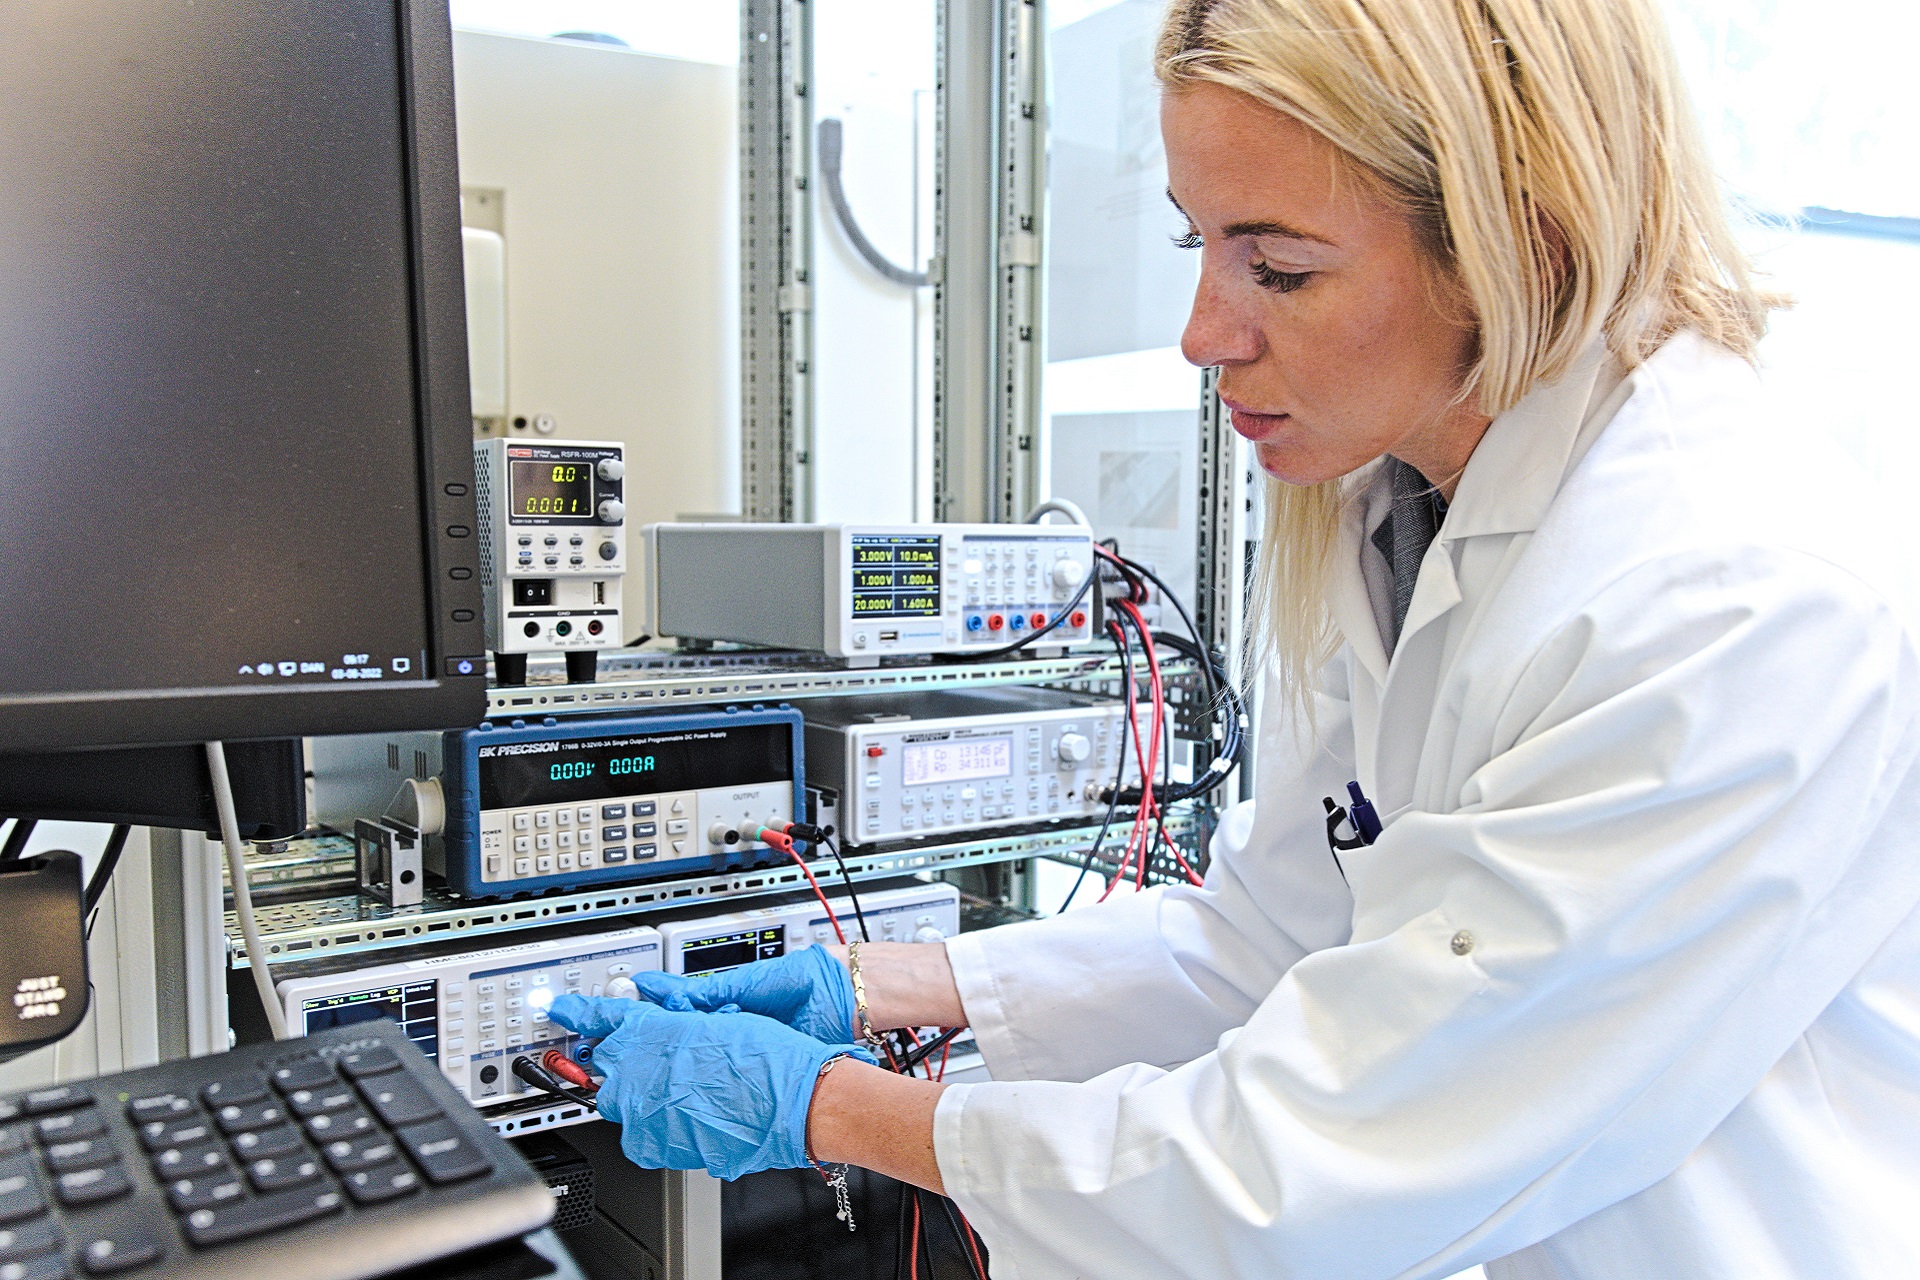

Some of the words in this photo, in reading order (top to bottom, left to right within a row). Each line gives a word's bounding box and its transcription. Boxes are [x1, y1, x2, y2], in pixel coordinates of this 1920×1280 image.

[560, 450, 599, 458] RSFR-100M
[552, 466, 576, 482] 0.0
[526, 498, 577, 514] 0.001
[479, 746, 496, 758] BK
[498, 742, 560, 756] PRECISION
[648, 736, 684, 744] Programmable
[733, 791, 760, 800] OUTPUT
